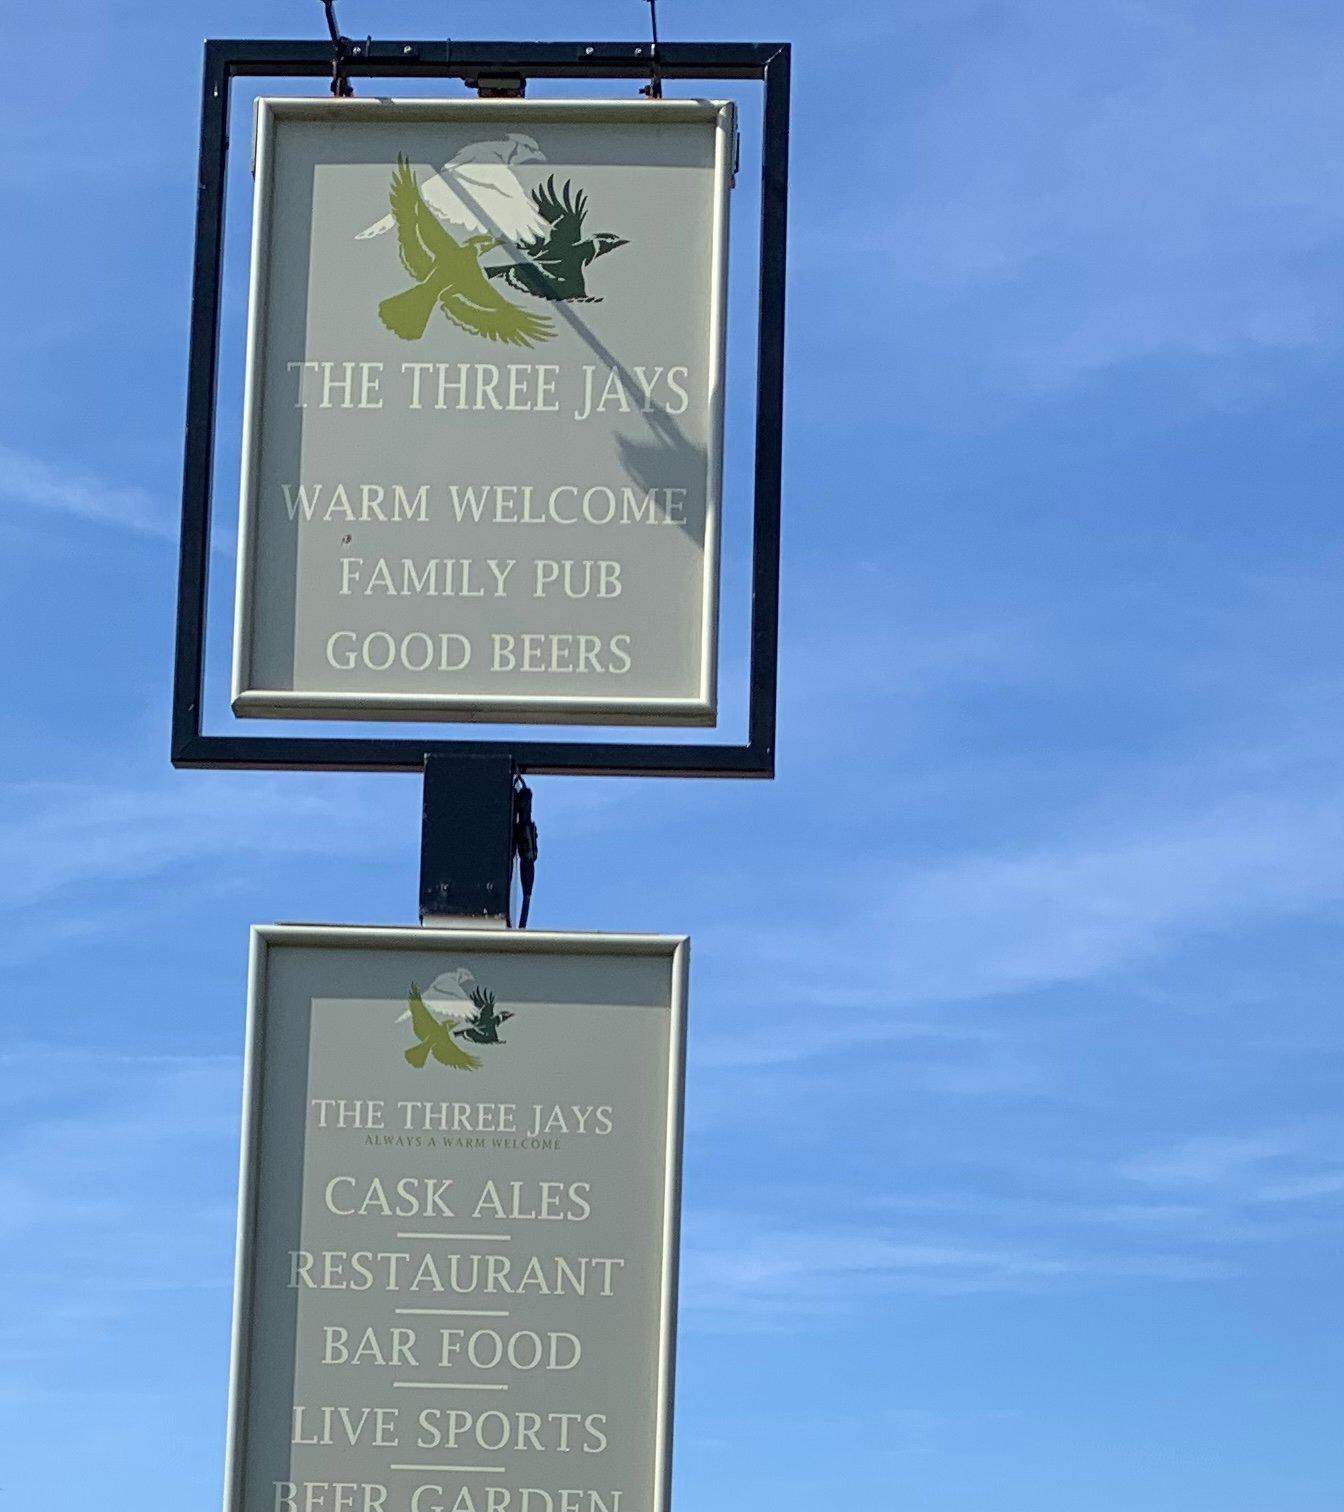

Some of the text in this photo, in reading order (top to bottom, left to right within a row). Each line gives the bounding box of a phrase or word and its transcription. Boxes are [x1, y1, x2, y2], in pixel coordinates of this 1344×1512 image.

[286, 361, 689, 421] THE THREE JAYS
[280, 483, 688, 525] WARM WELCOME
[338, 557, 622, 599] FAMILY PUB
[326, 630, 632, 674] GOOD BEERS
[311, 1099, 613, 1138] THE THREE JAYS
[364, 1134, 561, 1151] ALWAYS A WARM WELCOME
[325, 1176, 591, 1221] CASK ALES
[287, 1250, 625, 1297] RESTAURANT
[321, 1326, 582, 1370] BAR FOOD
[291, 1405, 607, 1453] LIVE SPORTS
